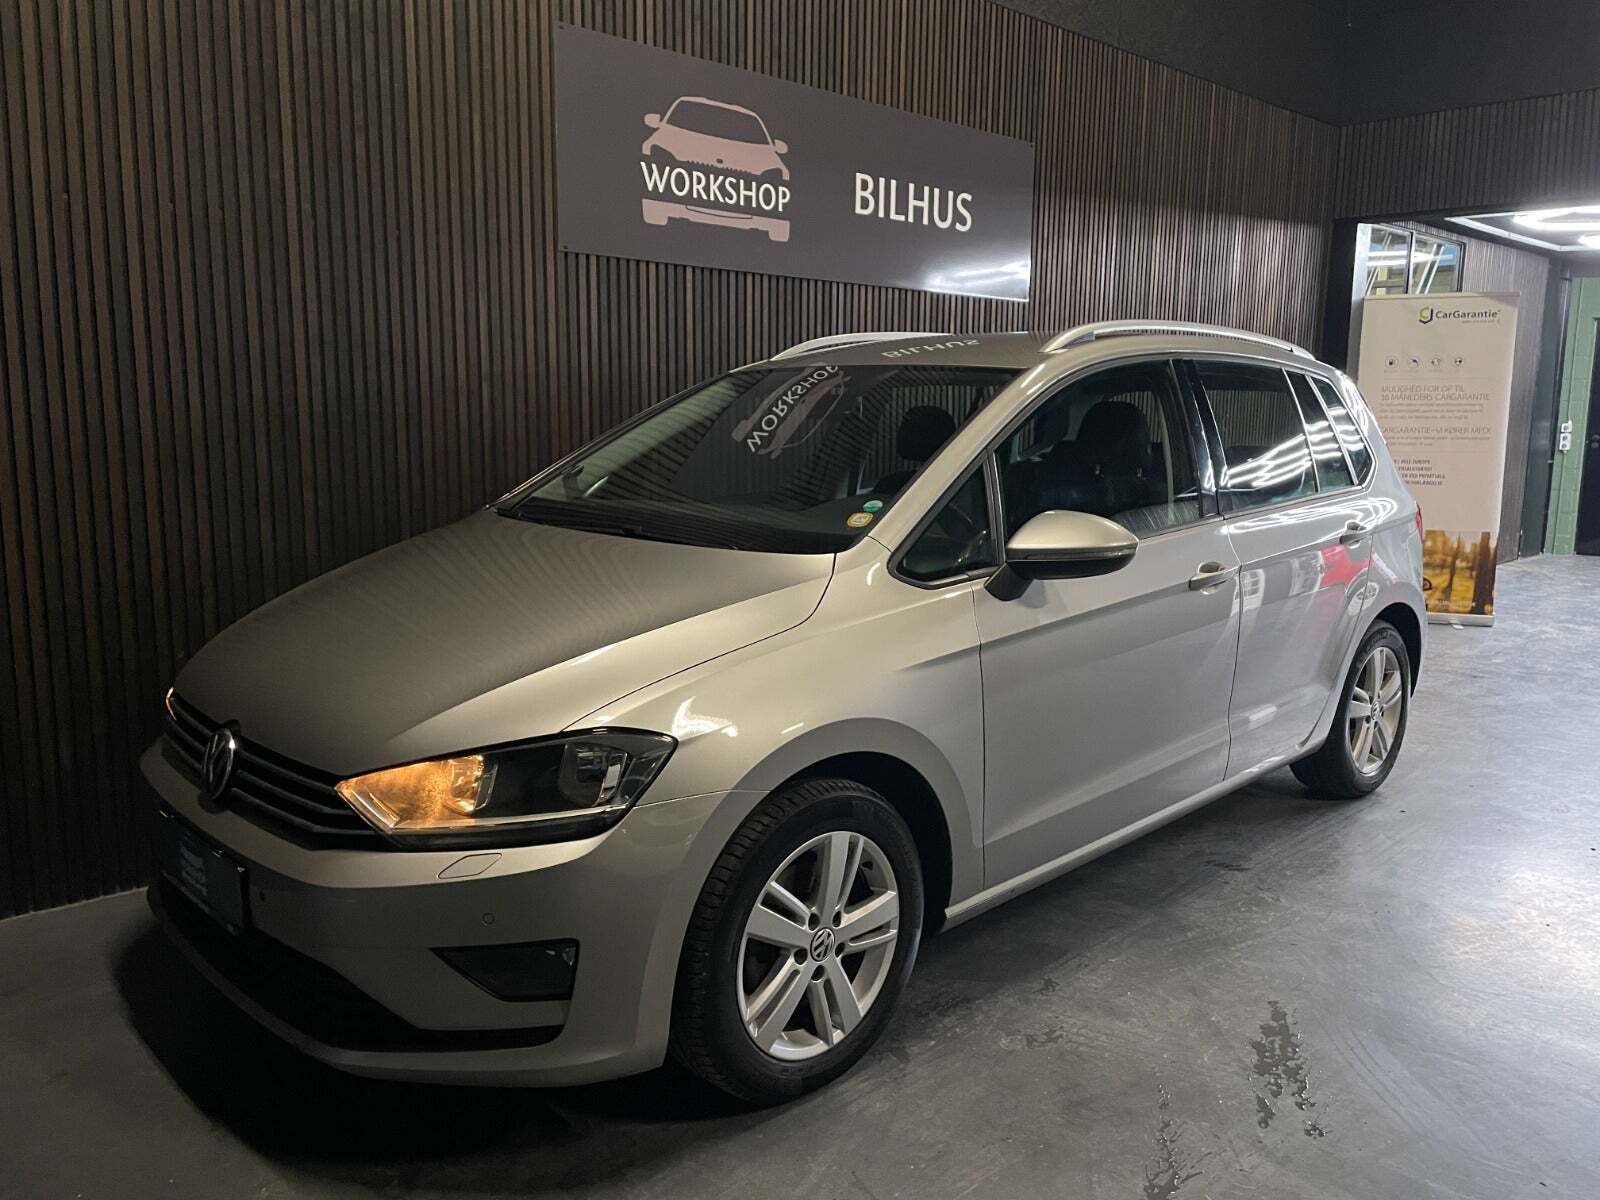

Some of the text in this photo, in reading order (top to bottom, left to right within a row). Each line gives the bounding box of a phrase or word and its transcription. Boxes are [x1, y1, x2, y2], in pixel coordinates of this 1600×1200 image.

[640, 160, 791, 213] WORKSHOP
[854, 171, 973, 233] BILHUS
[1435, 309, 1498, 319] CarGarantie
